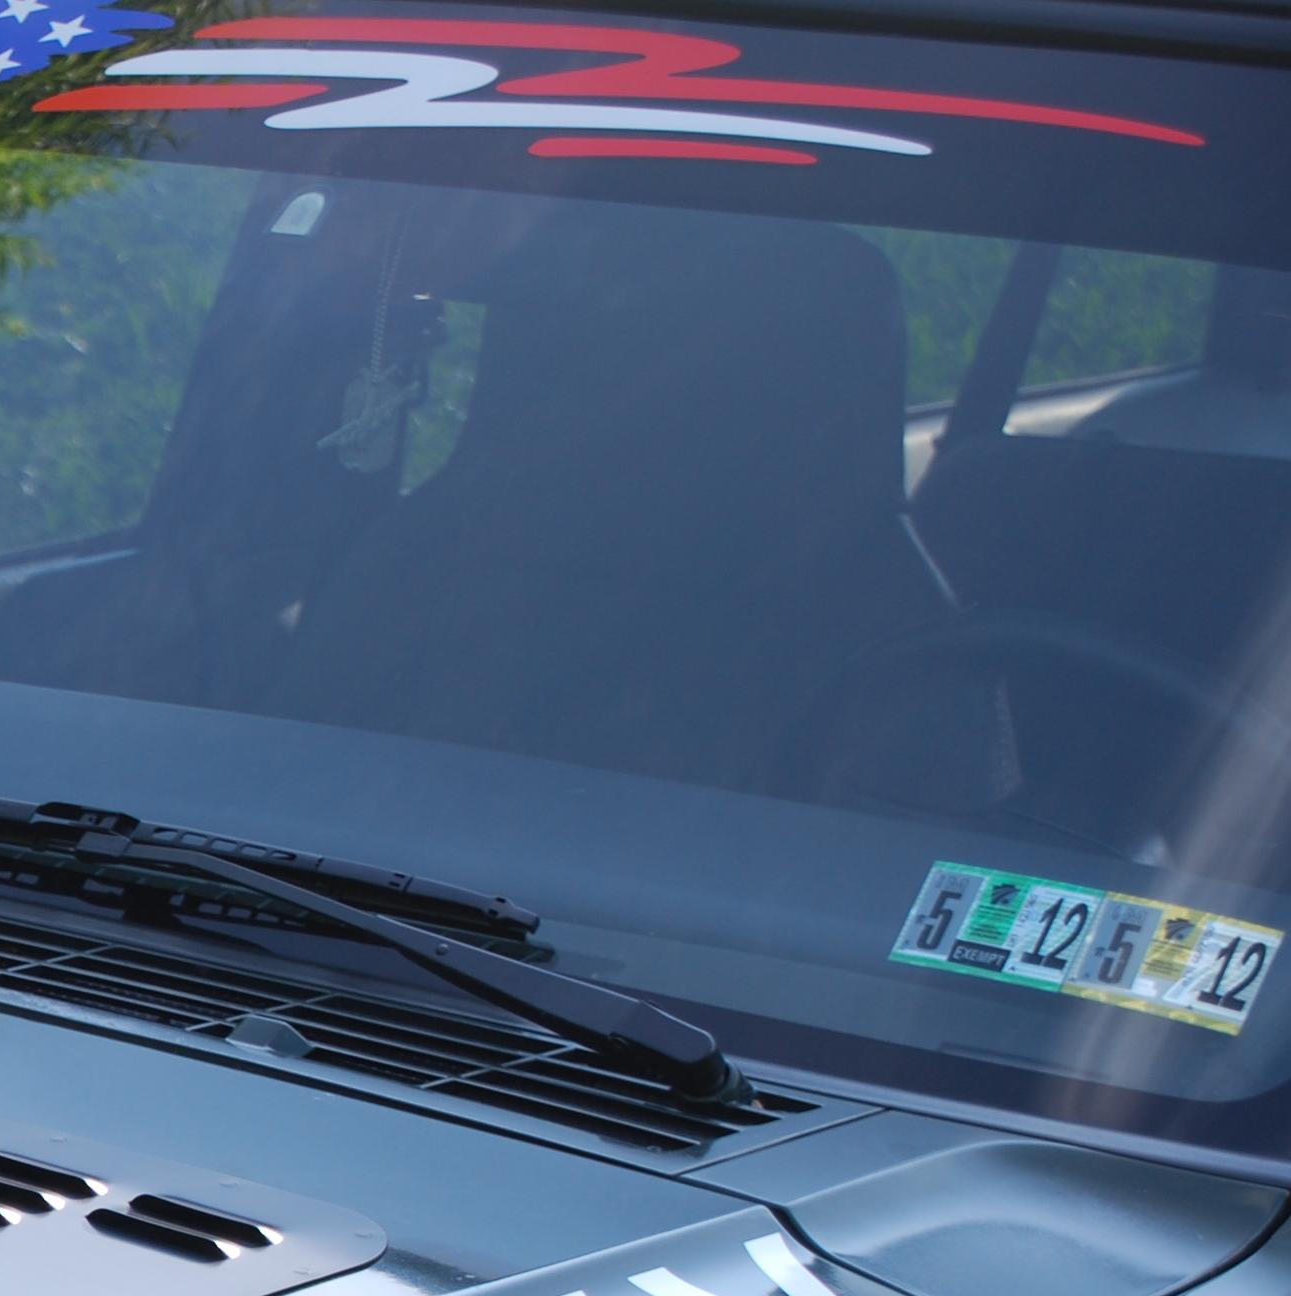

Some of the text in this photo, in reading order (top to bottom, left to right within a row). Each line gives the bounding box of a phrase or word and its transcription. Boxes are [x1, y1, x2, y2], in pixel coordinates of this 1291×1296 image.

[916, 891, 962, 950] 5
[1020, 897, 1089, 971] 12
[952, 945, 1007, 968] EXEMPT
[1098, 922, 1143, 985] 5
[1196, 936, 1267, 1012] 12
